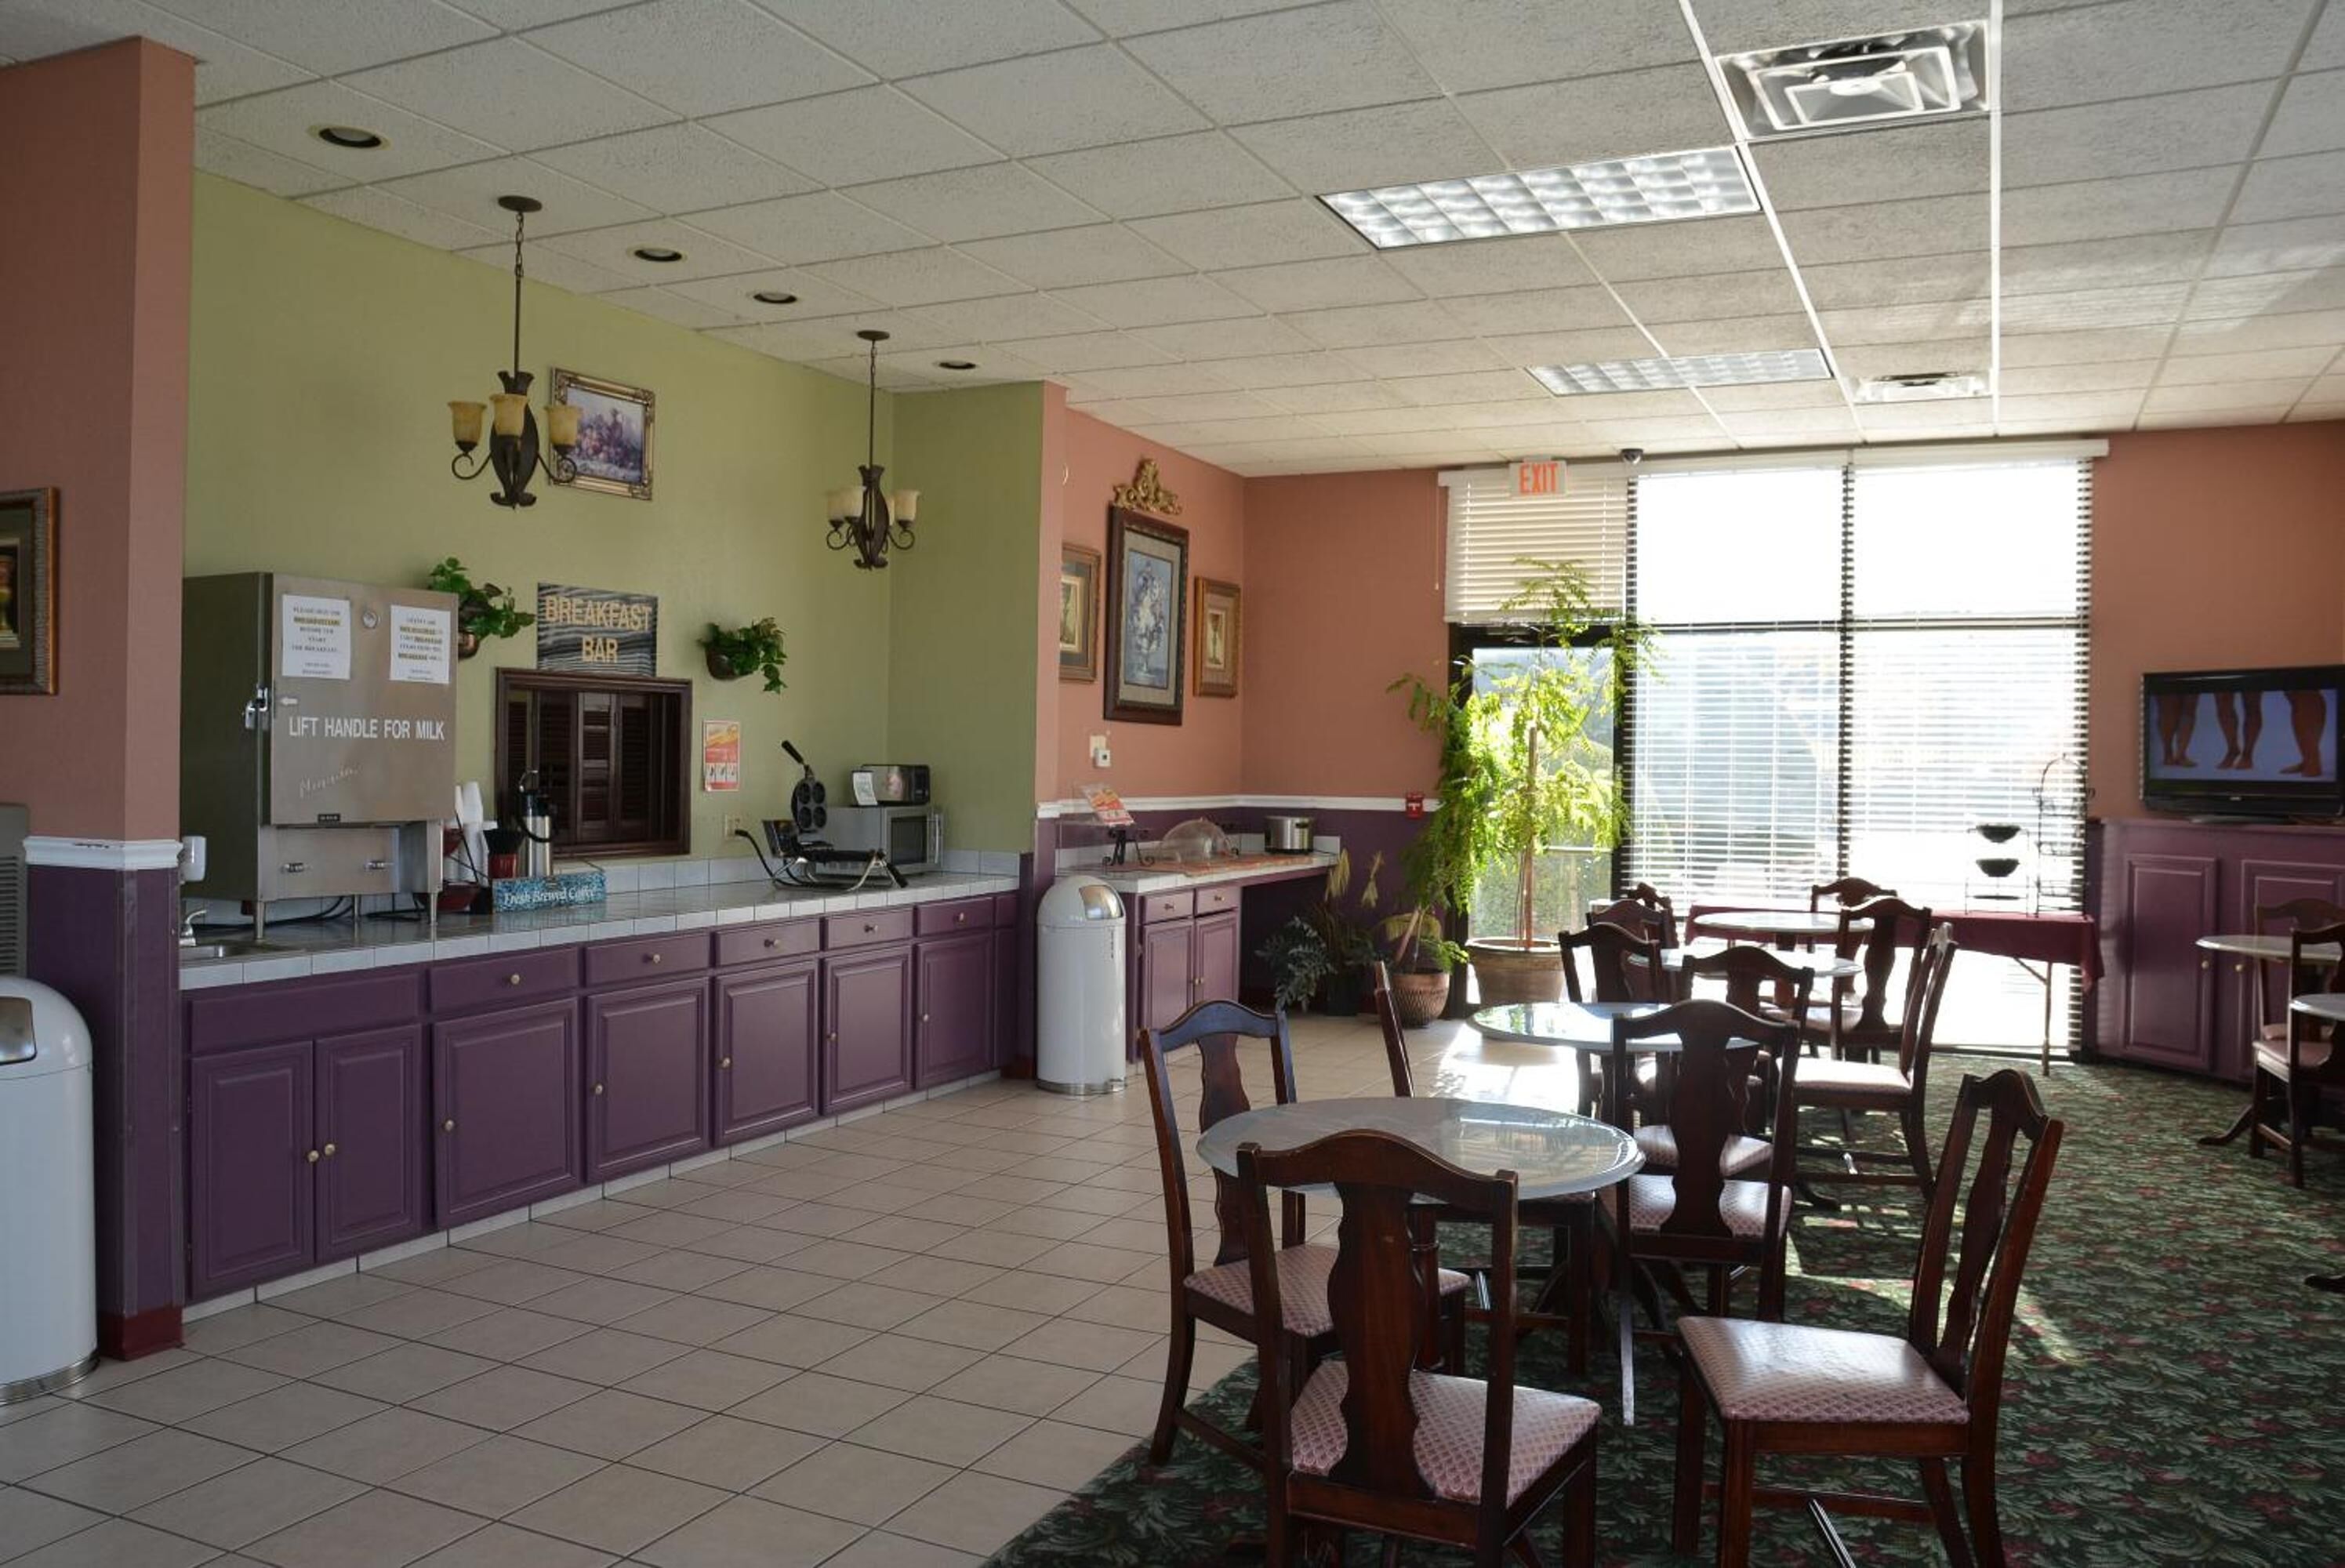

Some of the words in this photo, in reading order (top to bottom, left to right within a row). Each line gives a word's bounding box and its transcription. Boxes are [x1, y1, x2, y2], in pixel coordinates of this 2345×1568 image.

[1519, 463, 1558, 494] EXIT
[545, 595, 652, 632] BREAKFAST
[582, 636, 618, 663] BAR
[289, 716, 319, 737] LIFT
[325, 717, 378, 739] HANDLE
[384, 719, 411, 739] FOR
[416, 720, 445, 740] MILK
[503, 891, 530, 906] Fresh
[533, 888, 566, 902] Brewed
